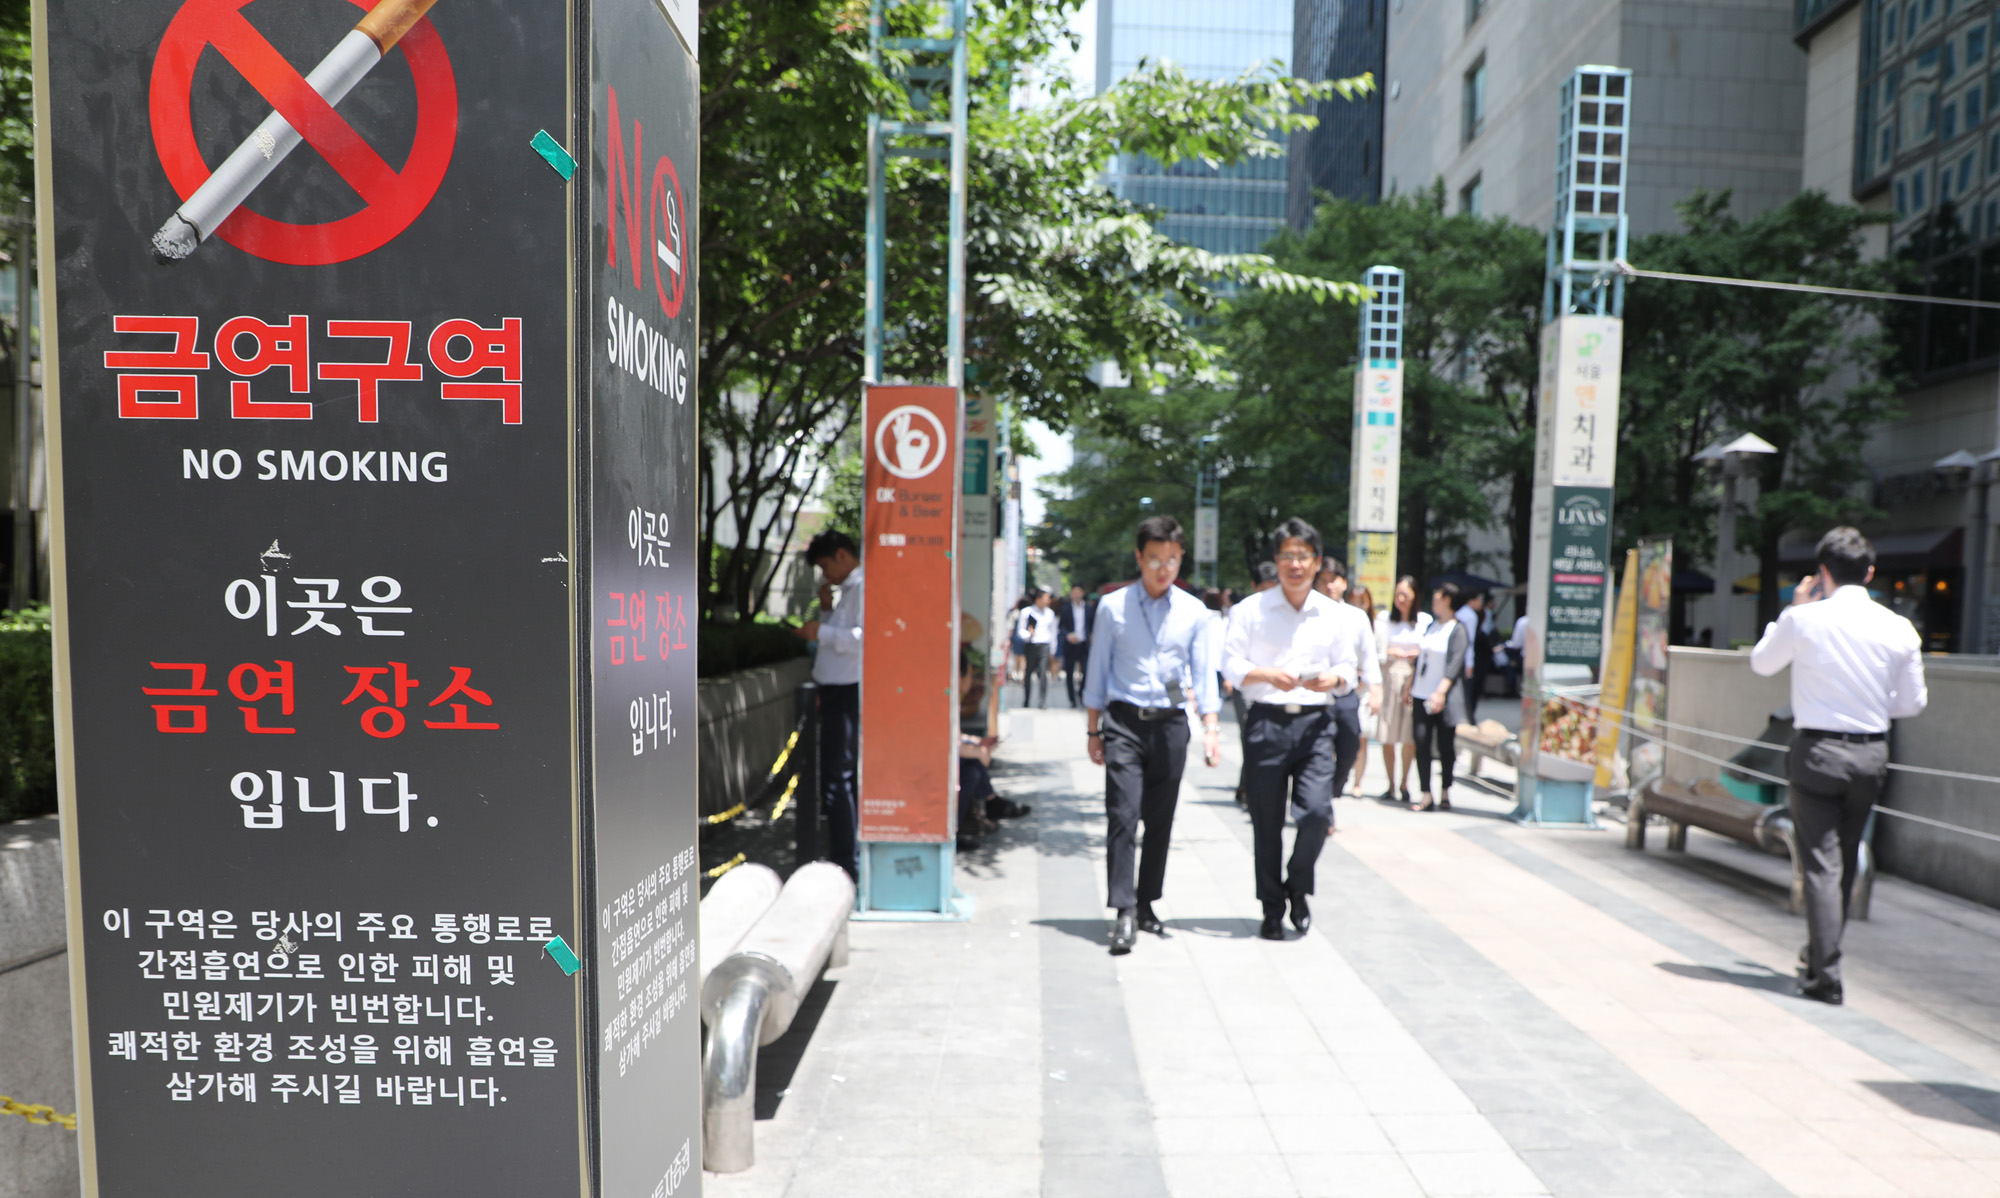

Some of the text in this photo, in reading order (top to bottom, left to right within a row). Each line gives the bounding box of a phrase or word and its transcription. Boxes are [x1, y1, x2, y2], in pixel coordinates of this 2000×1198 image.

[104, 315, 522, 424] 금연구역
[608, 296, 686, 405] SMOKING
[183, 449, 448, 482] NO SMOKING
[876, 487, 896, 503] OK
[629, 506, 671, 568] 이곳은
[224, 574, 412, 636] 이곳은
[607, 590, 687, 665] 금연 장소
[142, 660, 499, 738] 금연 장소
[630, 690, 676, 756] 입니다.
[230, 770, 439, 832] 입니다.
[603, 846, 694, 933] 이 구역은 당사의 주요 통행로로
[103, 908, 553, 944] 이 구역은 당사의 주요 통행로로
[611, 880, 688, 968] 간접흡연으로 인한 피해 및
[137, 950, 516, 986] 간접흡연으로 인한 피해 및
[618, 918, 685, 1001] 민원제기가 빈번합니다.
[163, 991, 494, 1026] 민원제기가 빈번합니다.
[604, 939, 695, 1052] 쾌적한 환경 조성을 위해 흡연을
[108, 1031, 558, 1067] 쾌적한 환경 조성을 위해 흡연을
[619, 980, 687, 1078] 삼가해 주시길 바랍니다.
[166, 1072, 507, 1106] 삼가해 주시길 바랍니다.
